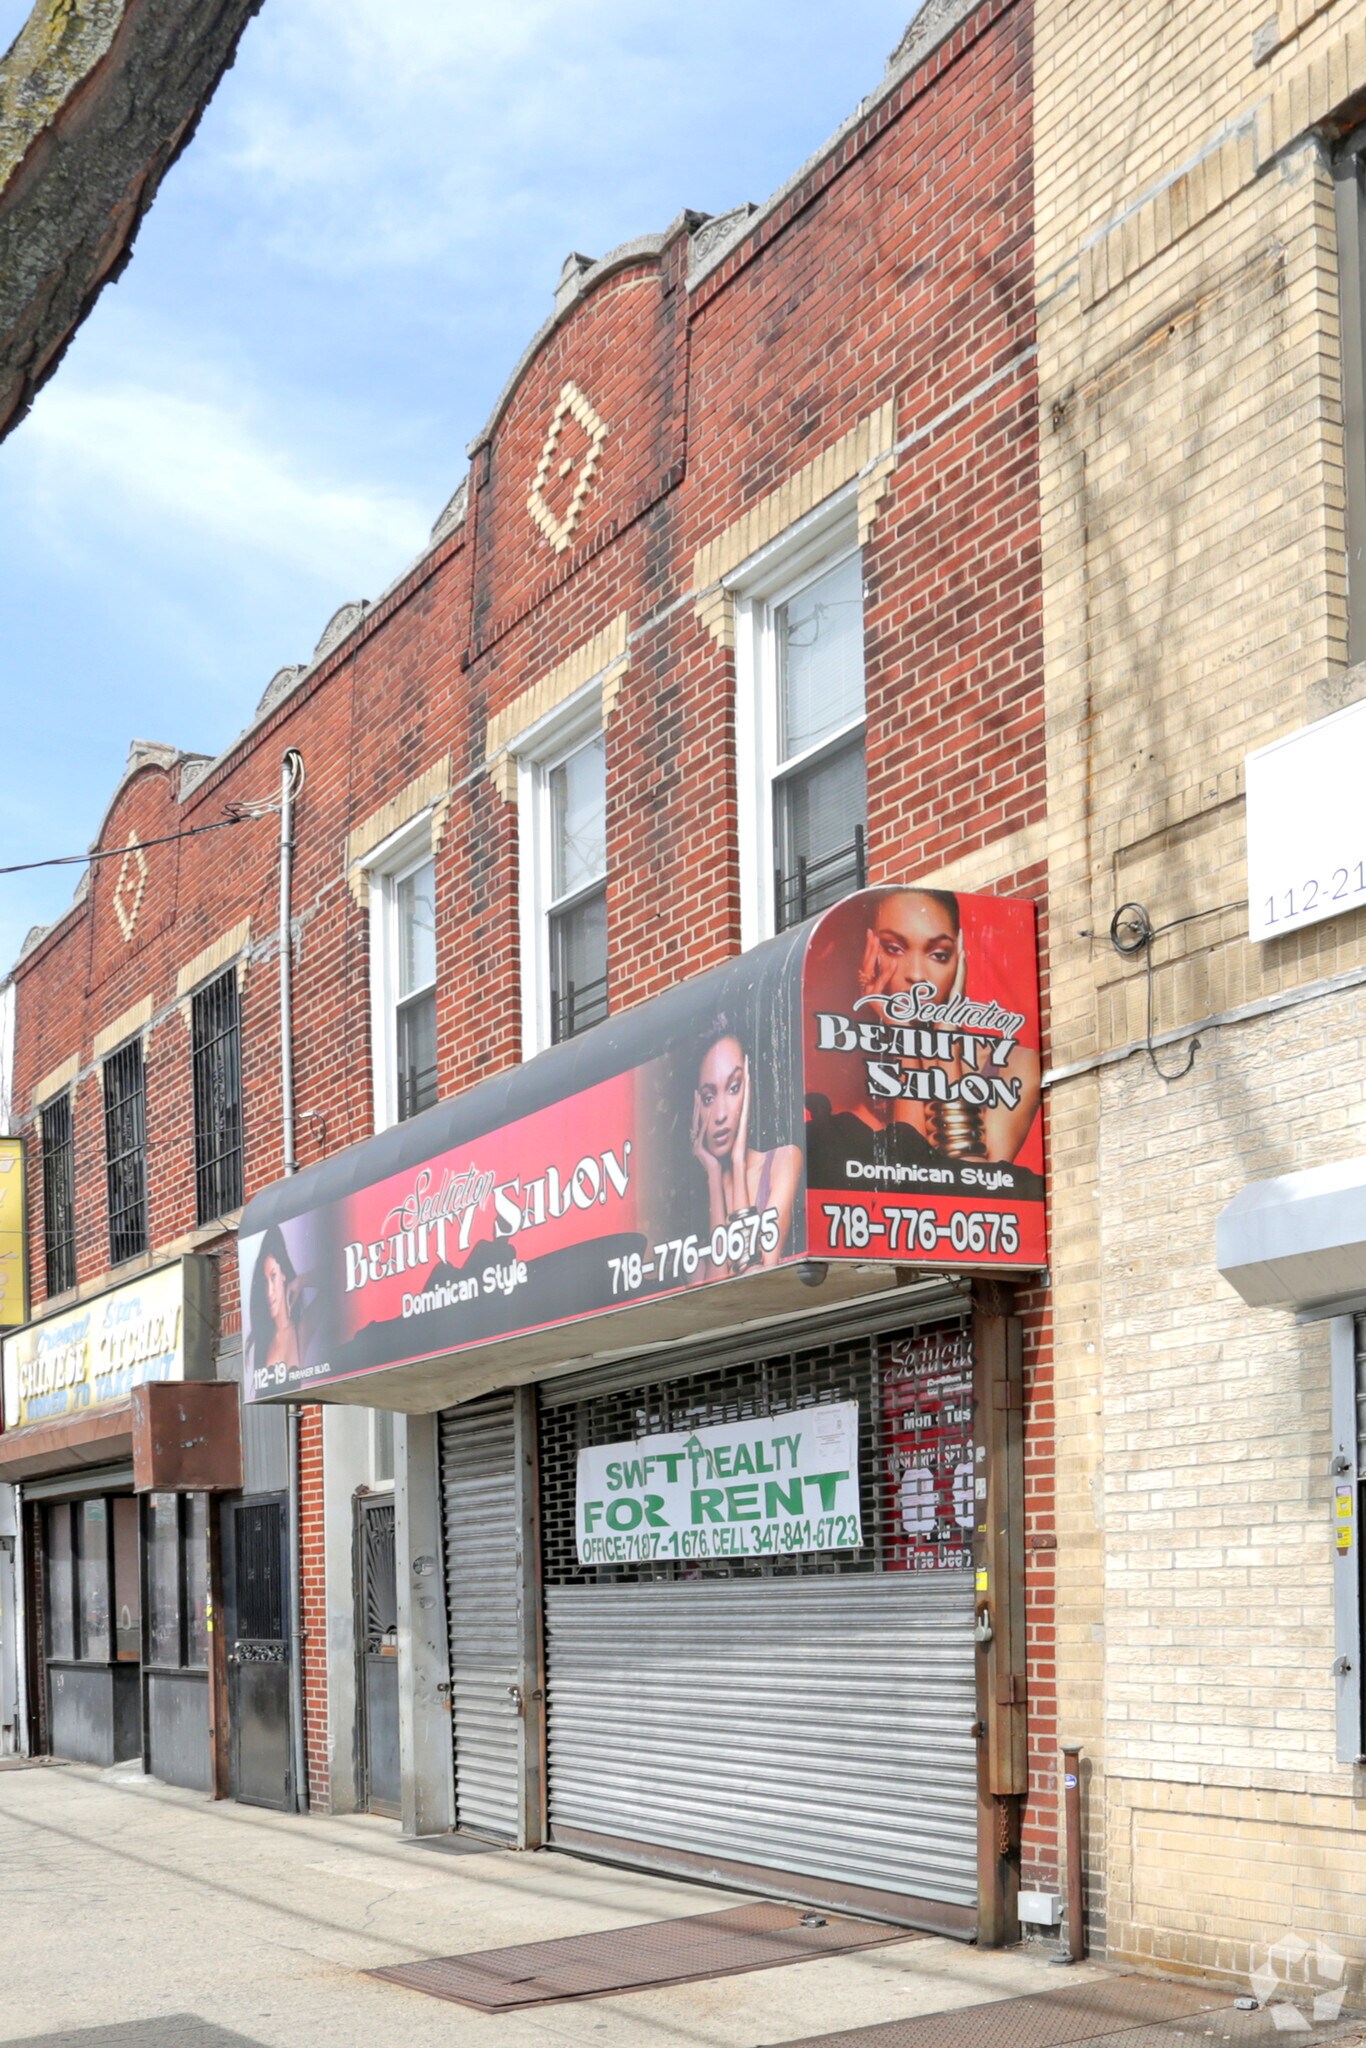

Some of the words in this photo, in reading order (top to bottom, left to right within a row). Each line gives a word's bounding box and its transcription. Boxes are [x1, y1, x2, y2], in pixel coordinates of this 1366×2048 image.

[1263, 860, 1366, 926] 112-21
[852, 980, 1026, 1038] Seduction
[381, 1161, 496, 1235] Seduction
[845, 1159, 955, 1185] Dominican
[960, 1167, 1015, 1191] Style
[606, 1207, 780, 1295] 718-776-0675
[823, 1203, 1020, 1255] 718-776-0675
[401, 1278, 479, 1319] Dominican
[482, 1261, 528, 1296] Style
[19, 1341, 88, 1401] CHINESE
[94, 1304, 181, 1379] KITCHEN
[254, 1362, 287, 1390] 112-19
[27, 1390, 68, 1421] ORDER
[73, 1382, 91, 1408] TO
[95, 1368, 135, 1403] TAKE
[704, 1433, 802, 1480] REALTY
[584, 1494, 671, 1533] FOR
[690, 1470, 850, 1525] RENT
[712, 1528, 749, 1555] CELL
[751, 1514, 859, 1553] 347-841-6723
[906, 1546, 934, 1569] Free
